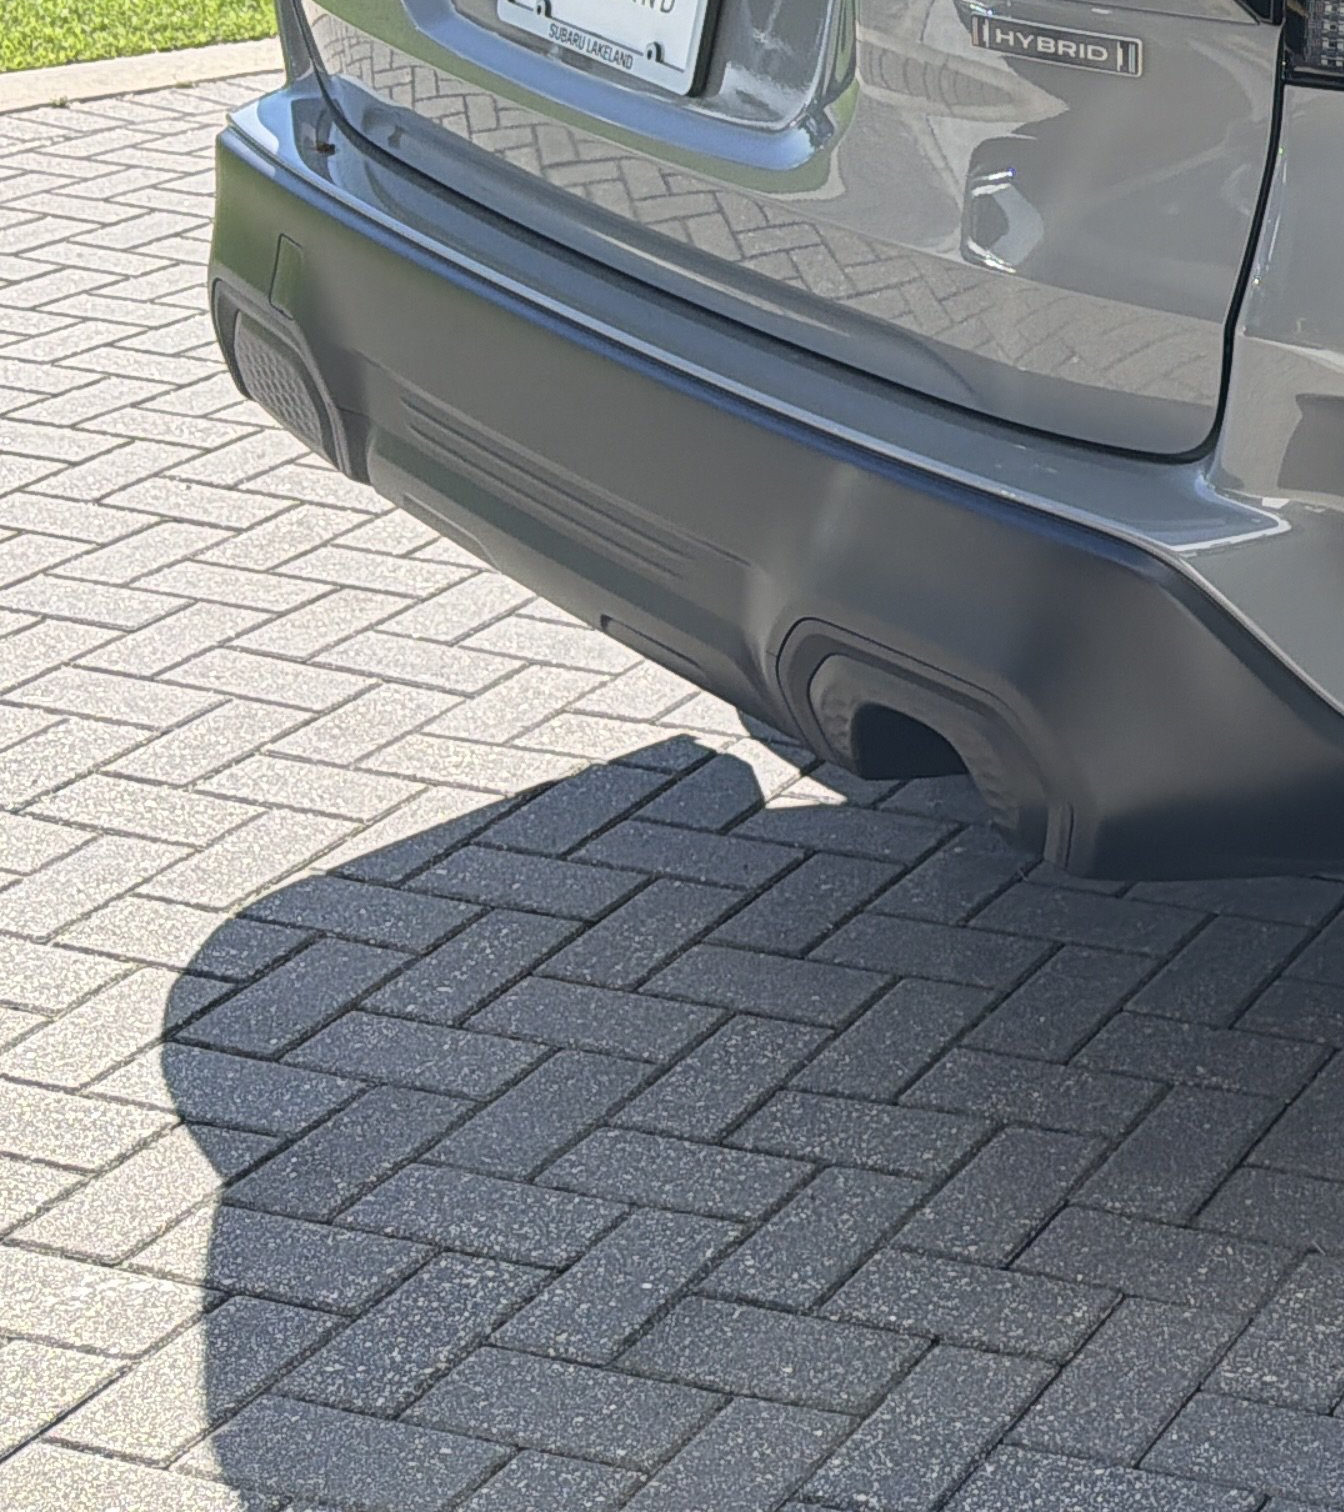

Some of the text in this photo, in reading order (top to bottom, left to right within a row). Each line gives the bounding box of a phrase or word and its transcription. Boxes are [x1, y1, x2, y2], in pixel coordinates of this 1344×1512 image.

[549, 23, 633, 71] SUBARU LAKELAND
[995, 28, 1109, 62] HYBRID
